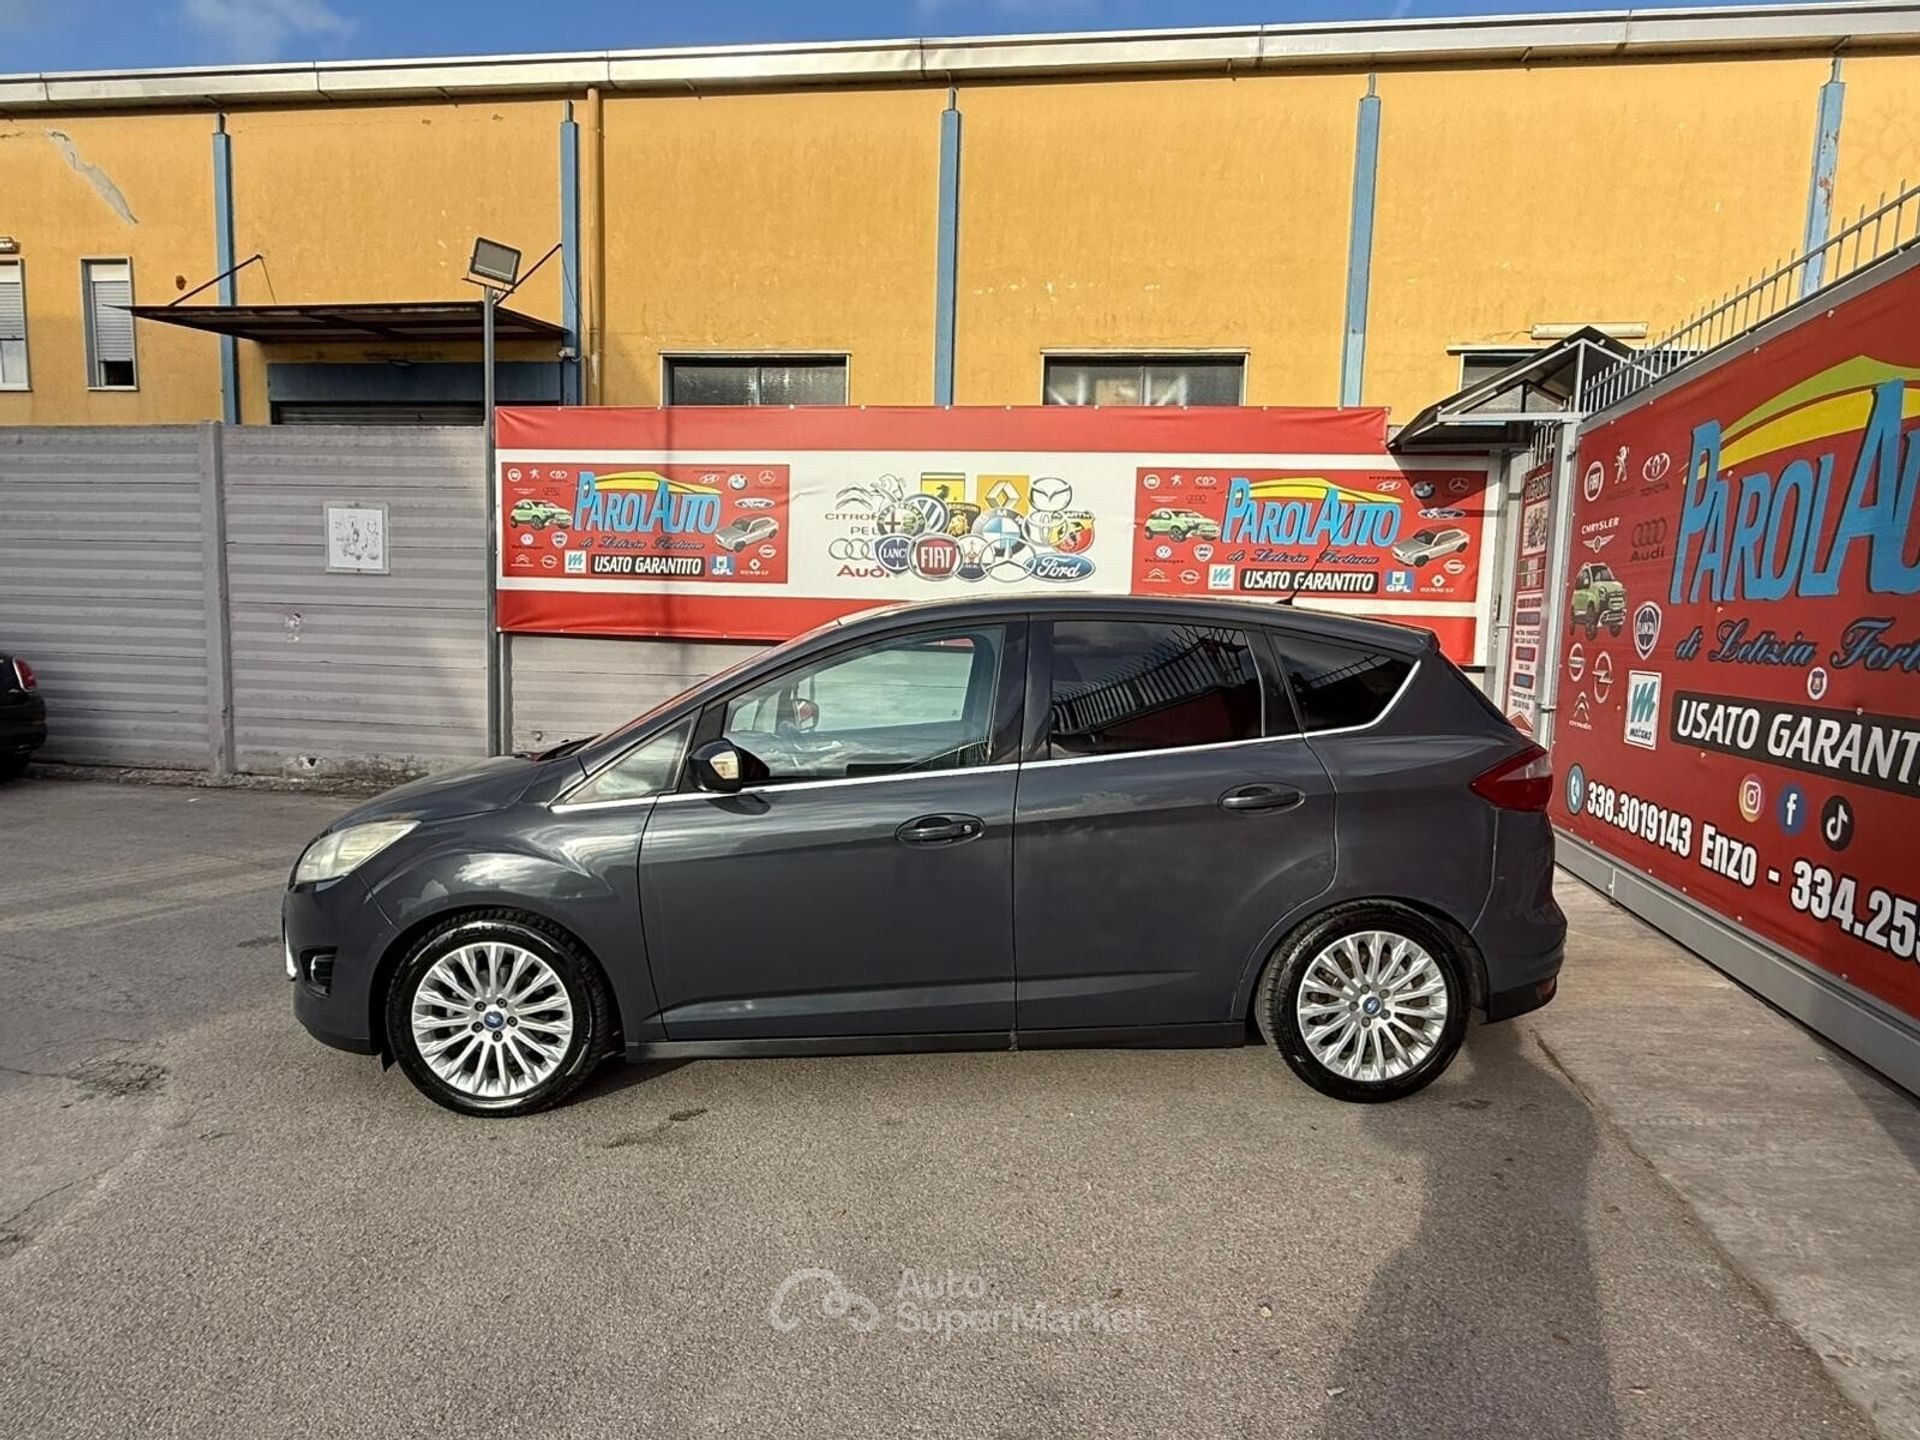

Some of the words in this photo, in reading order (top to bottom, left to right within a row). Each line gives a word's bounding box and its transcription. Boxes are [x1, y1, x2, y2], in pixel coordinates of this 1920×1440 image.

[574, 471, 721, 534] PAROLAUTO
[1222, 477, 1401, 547] PAROLAUTO
[1581, 517, 1619, 534] CHRYSLER
[920, 547, 953, 569] FIAT
[1632, 546, 1665, 562] Audi
[594, 556, 632, 573] USATO
[634, 557, 701, 575] GARANTITO
[712, 567, 733, 575] GPL
[1036, 556, 1080, 577] Ford
[1244, 570, 1290, 589] USATO
[1294, 571, 1375, 592] GARANTITO
[1386, 584, 1411, 592] GPL
[1676, 626, 1703, 661] di
[1708, 618, 1818, 667] Letizia
[1677, 700, 1760, 750] USATO
[1767, 713, 1920, 785] GARANT
[1587, 781, 1693, 857] 338.3019143
[1790, 860, 1920, 965] 334.25
